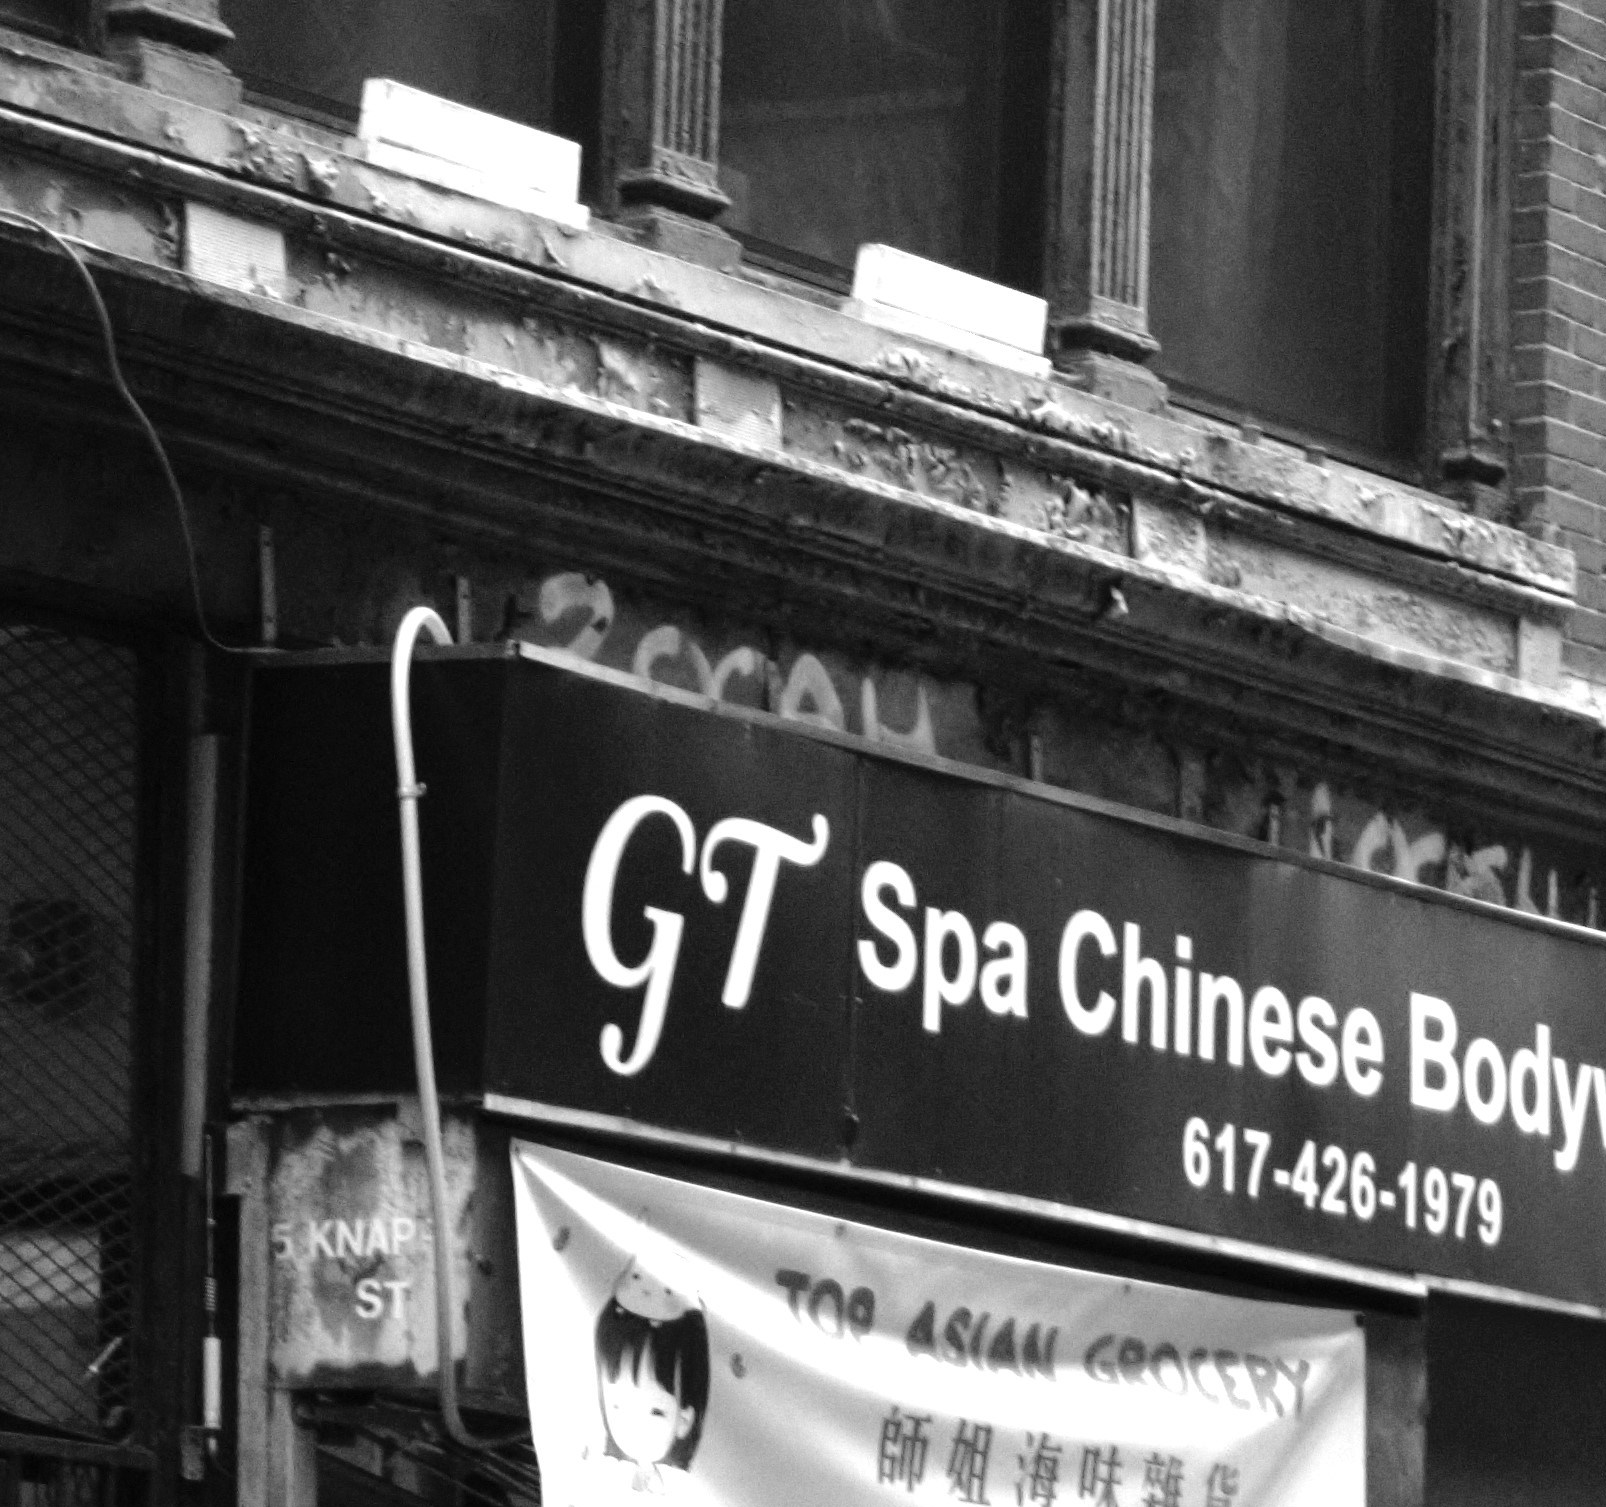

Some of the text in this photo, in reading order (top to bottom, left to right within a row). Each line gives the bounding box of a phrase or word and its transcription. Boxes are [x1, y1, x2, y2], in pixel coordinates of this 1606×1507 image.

[581, 793, 830, 1078] GT
[856, 859, 1029, 1035] Spa
[1057, 908, 1386, 1099] Chinese
[272, 1217, 433, 1261] 5 KNAP
[1182, 1116, 1504, 1247] 617-426-1979
[356, 1278, 412, 1319] ST
[775, 1268, 1311, 1420] TOP ASIAN GROCERY
